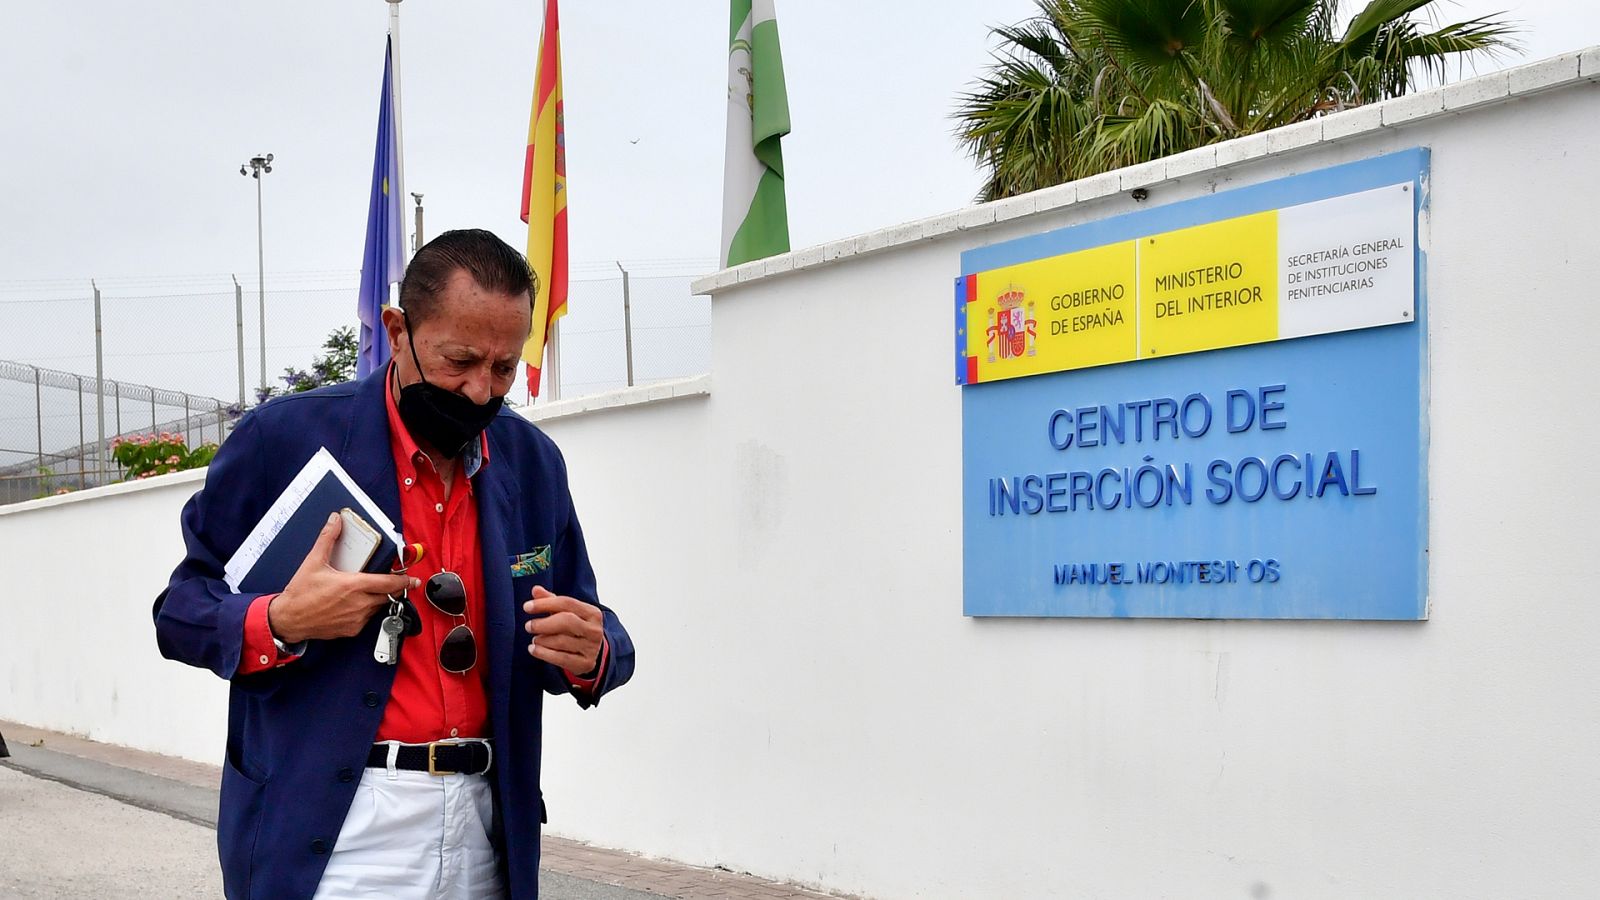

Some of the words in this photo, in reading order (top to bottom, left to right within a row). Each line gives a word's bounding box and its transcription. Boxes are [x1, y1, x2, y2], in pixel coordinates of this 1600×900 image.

[1287, 246, 1349, 268] SECRETARÍA
[1352, 238, 1404, 256] GENERAL
[1155, 262, 1243, 293] MINISTERIO
[1287, 272, 1302, 284] DE
[1304, 256, 1388, 281] INSTITUCIONES
[1050, 284, 1125, 312] GOBIERNO
[1155, 301, 1183, 319] DEL
[1187, 285, 1263, 314] INTERIOR
[1287, 277, 1374, 300] PENITENCIARIAS
[1051, 320, 1068, 336] DE
[1072, 308, 1124, 332] ESPAÑA
[1047, 392, 1212, 451] CENTRO
[1226, 384, 1287, 434] DE
[988, 455, 1192, 516] INSERCIÓN
[1205, 449, 1377, 505] SOCIAL
[1053, 562, 1133, 585] MANUEL
[1136, 559, 1281, 584] MONTESIOS
